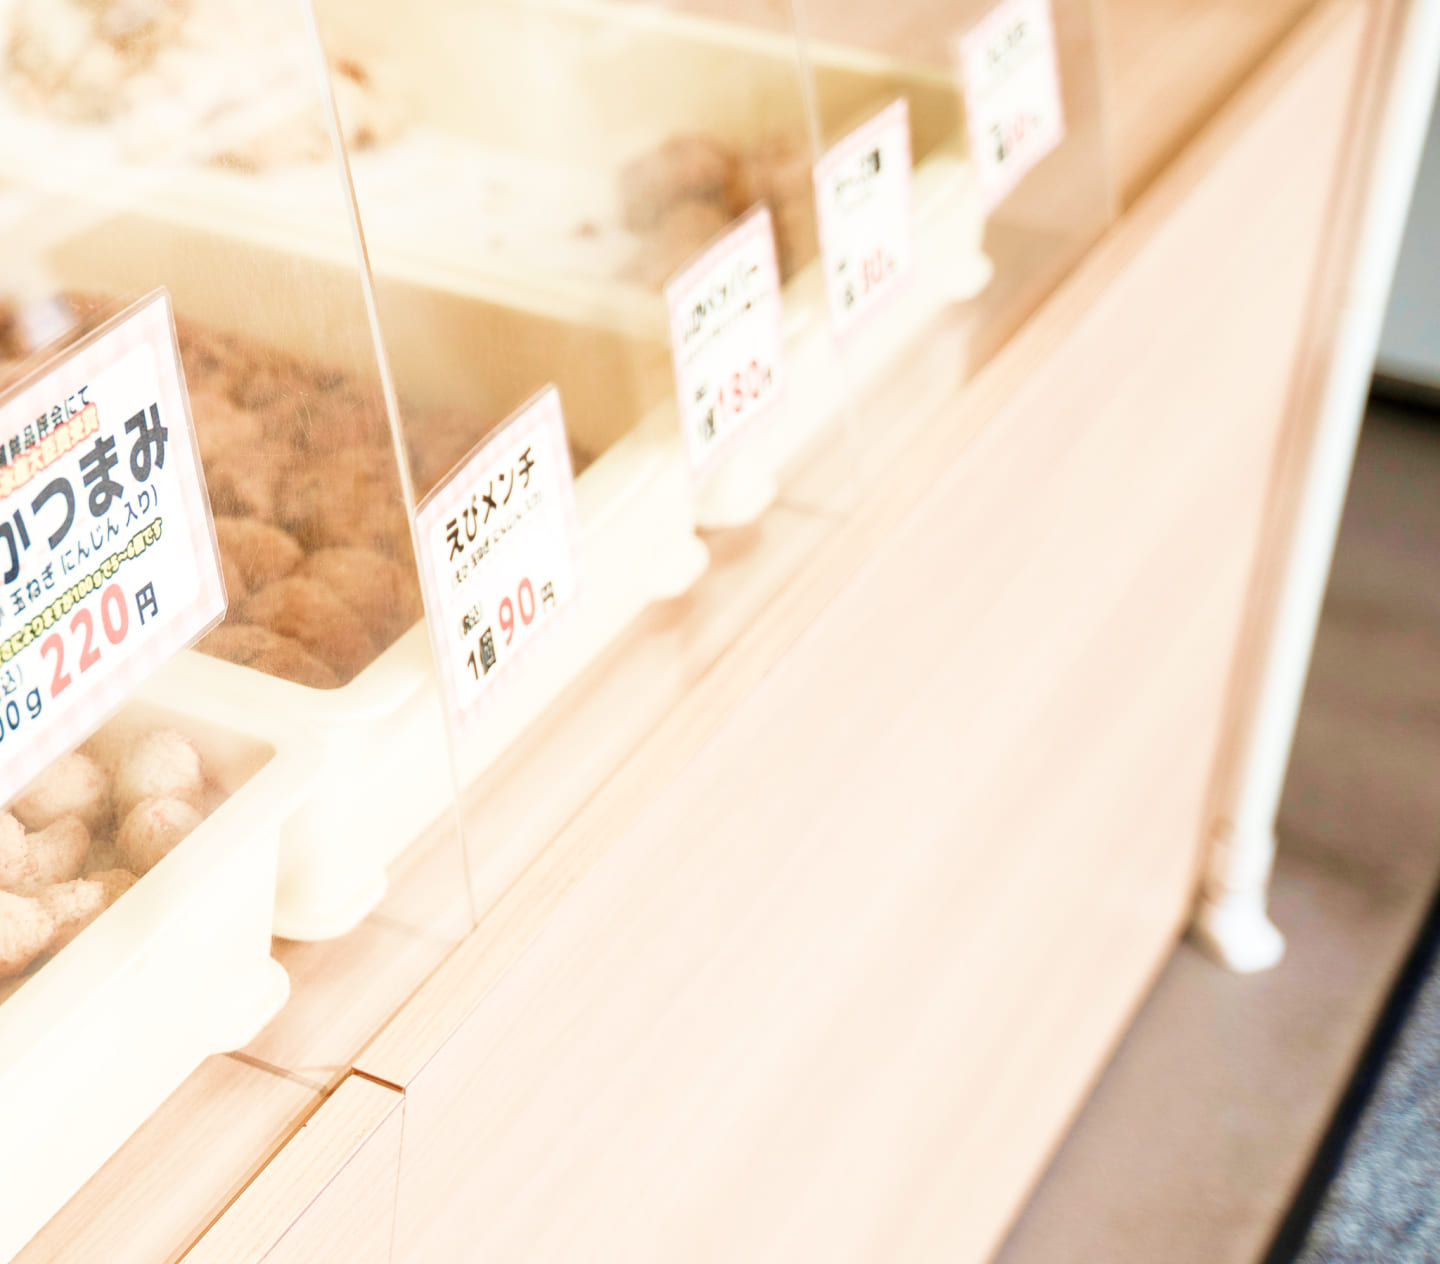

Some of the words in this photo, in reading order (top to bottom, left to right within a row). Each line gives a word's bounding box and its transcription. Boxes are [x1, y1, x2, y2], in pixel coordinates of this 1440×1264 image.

[10, 562, 56, 615] 玉ねぎ
[61, 520, 119, 574] にんじん
[124, 484, 158, 527] 入り)
[446, 445, 535, 562] えびメンチ
[40, 583, 129, 698] 220
[136, 581, 159, 625] 円
[466, 626, 497, 681] 1個
[498, 576, 536, 648] 90
